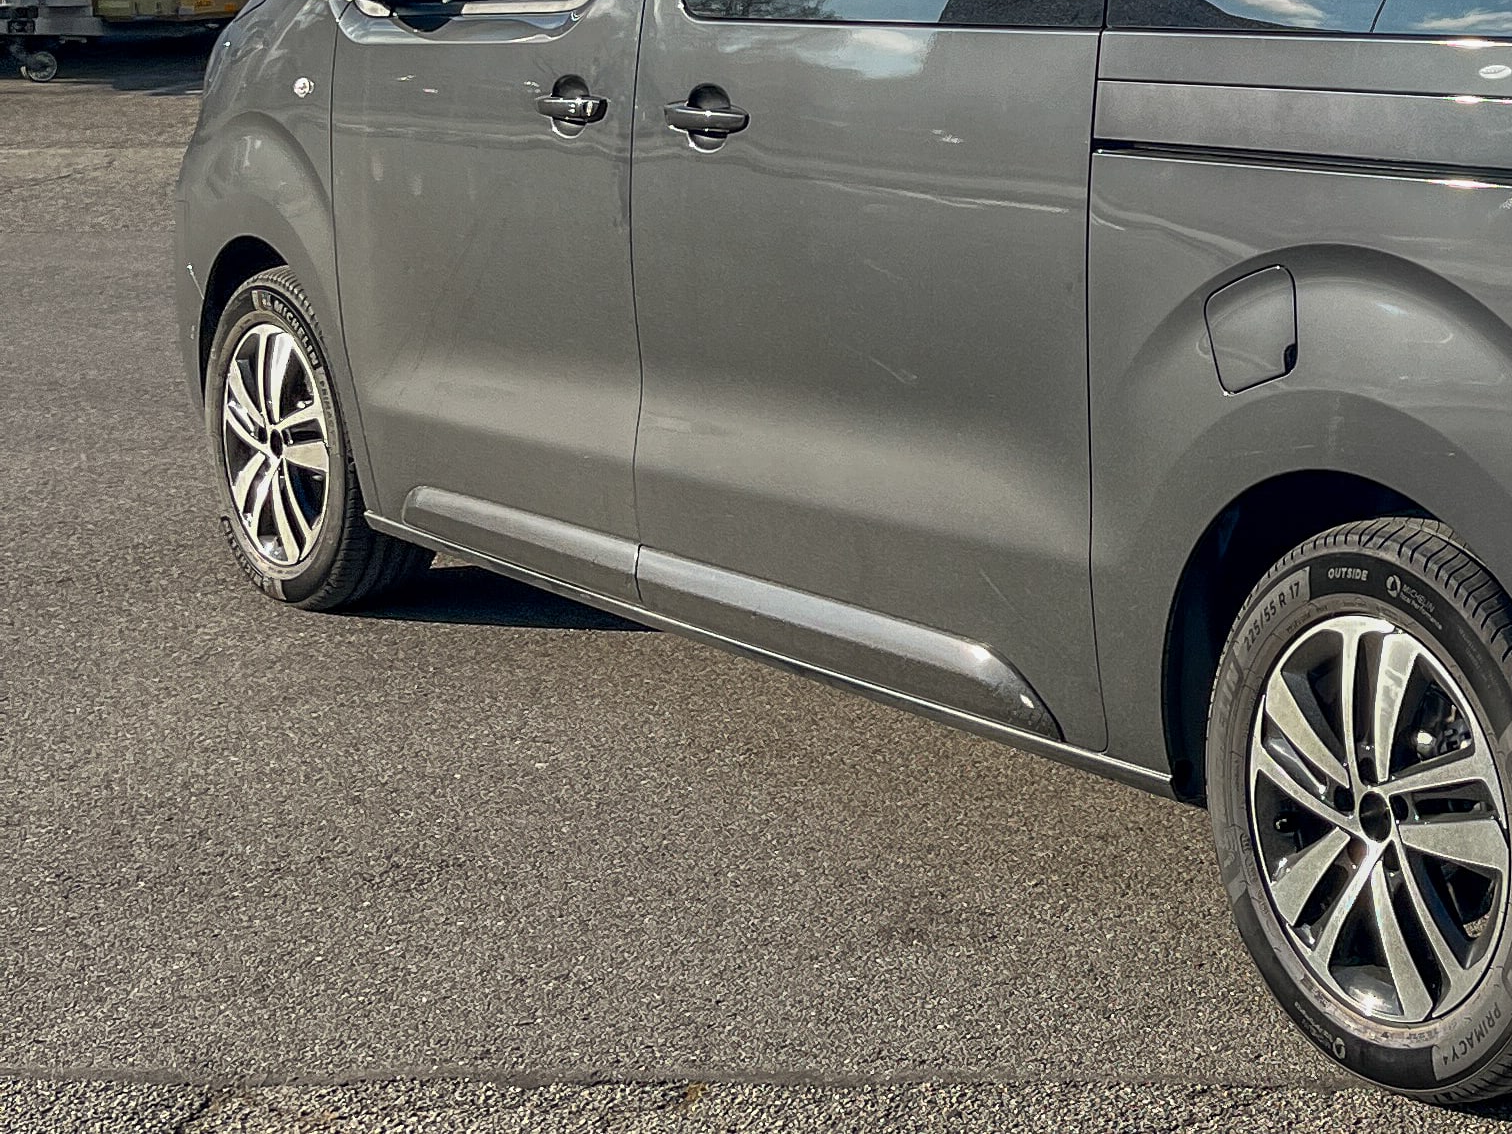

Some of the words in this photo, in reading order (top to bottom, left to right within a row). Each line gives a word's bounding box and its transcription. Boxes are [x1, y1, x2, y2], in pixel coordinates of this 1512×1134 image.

[273, 299, 319, 366] MICHELIN
[1327, 567, 1369, 581] OUTSIDE
[1243, 600, 1277, 652] 225/55
[1278, 591, 1287, 608] R
[1289, 581, 1300, 599] 17
[1451, 1002, 1502, 1062] PRIMACY
